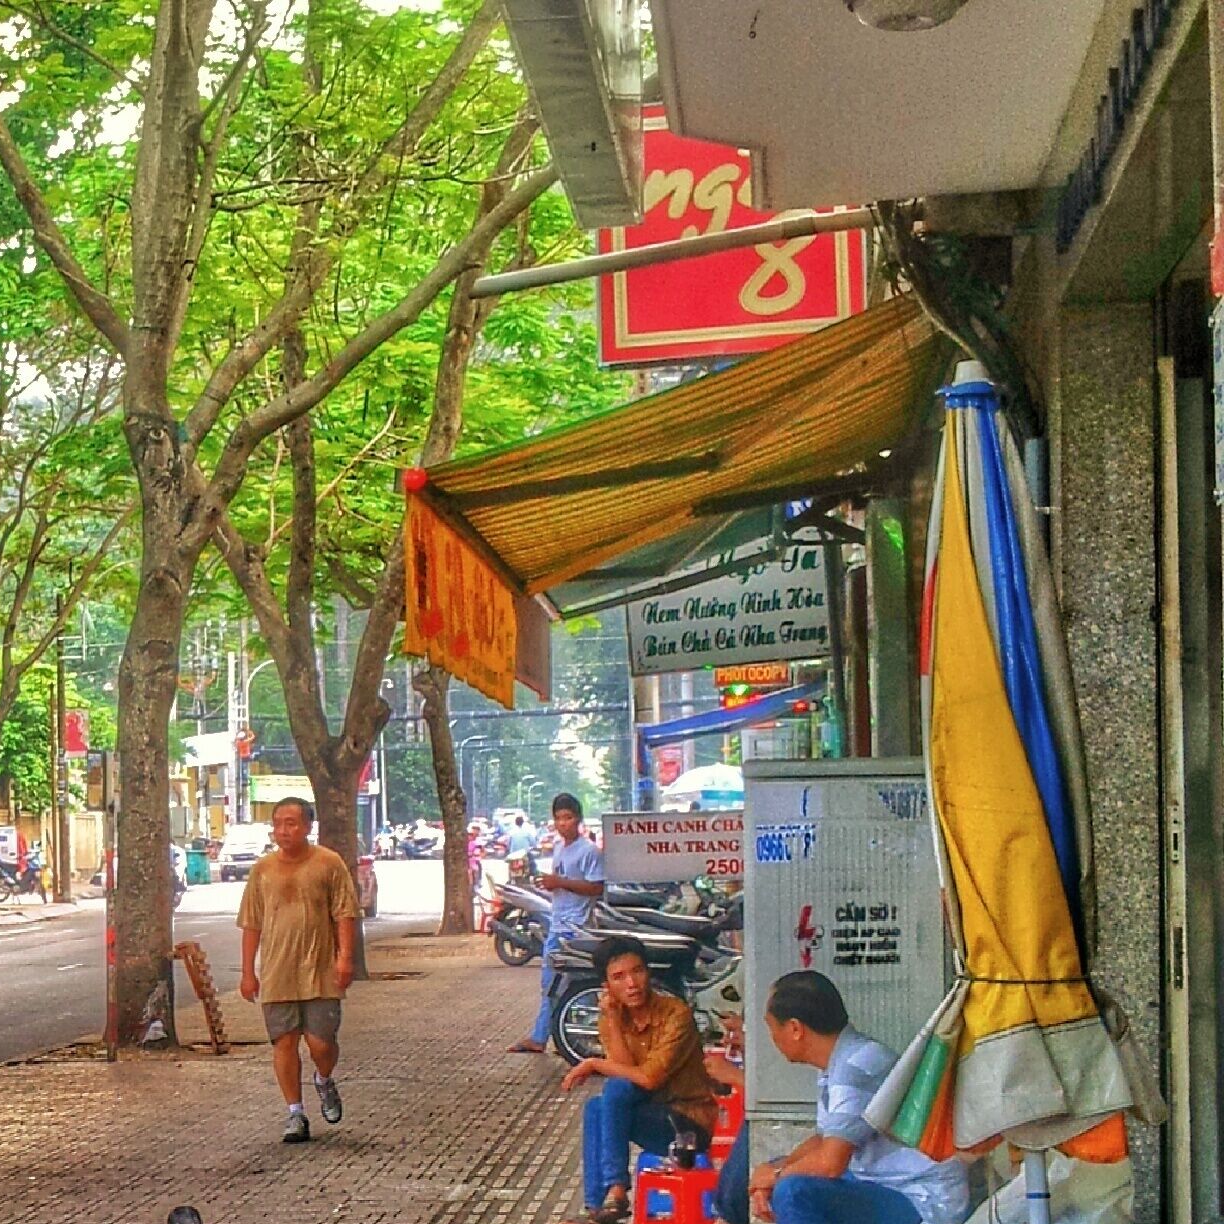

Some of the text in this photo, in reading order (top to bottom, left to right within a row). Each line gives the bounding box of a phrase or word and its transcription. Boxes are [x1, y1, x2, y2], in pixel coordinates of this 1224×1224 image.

[643, 602, 681, 625] Nem
[741, 590, 782, 614] Ninh
[741, 624, 775, 648] Nha
[779, 620, 828, 645] Trang
[717, 666, 787, 681] PHOTOCOPY
[614, 818, 658, 835] BÁNH
[662, 819, 707, 834] CANH
[647, 839, 740, 854] NHA TRANG
